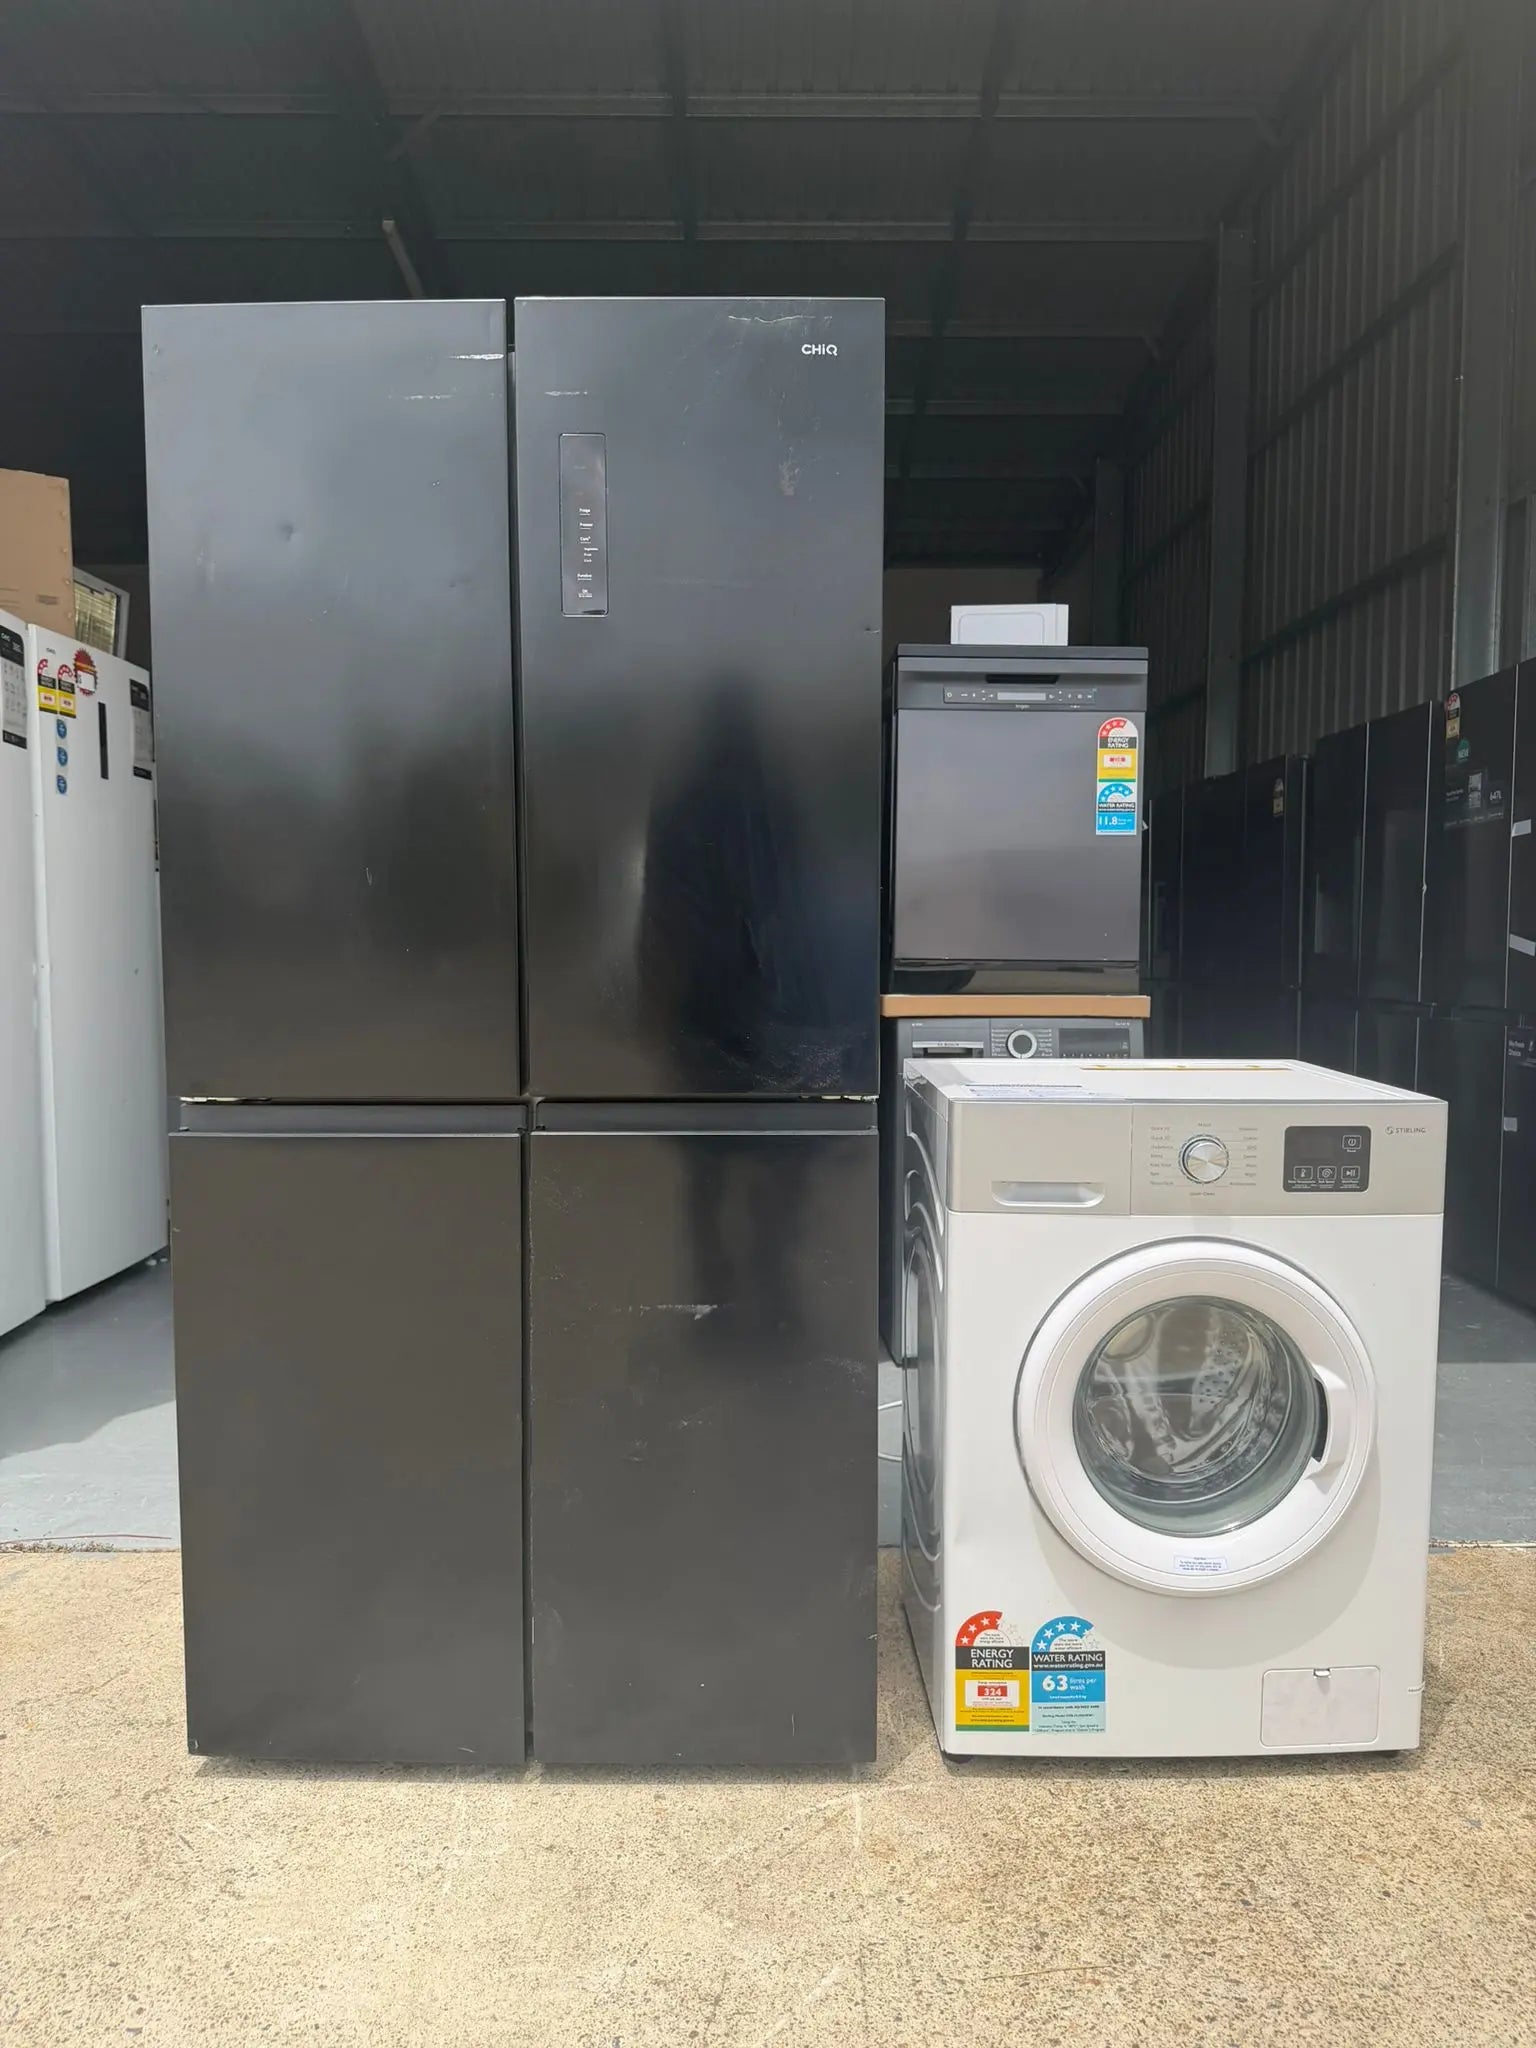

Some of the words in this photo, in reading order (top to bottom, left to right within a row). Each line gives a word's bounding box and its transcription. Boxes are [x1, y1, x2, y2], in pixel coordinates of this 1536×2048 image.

[801, 343, 839, 356] CHiQ
[1099, 816, 1118, 825] 11.8
[971, 1649, 1014, 1659] ENERGY
[1033, 1654, 1065, 1662] WATER
[1068, 1653, 1103, 1662] RATING
[972, 1659, 1013, 1669] RATING
[1042, 1675, 1068, 1692] 63
[984, 1687, 1002, 1696] 324
